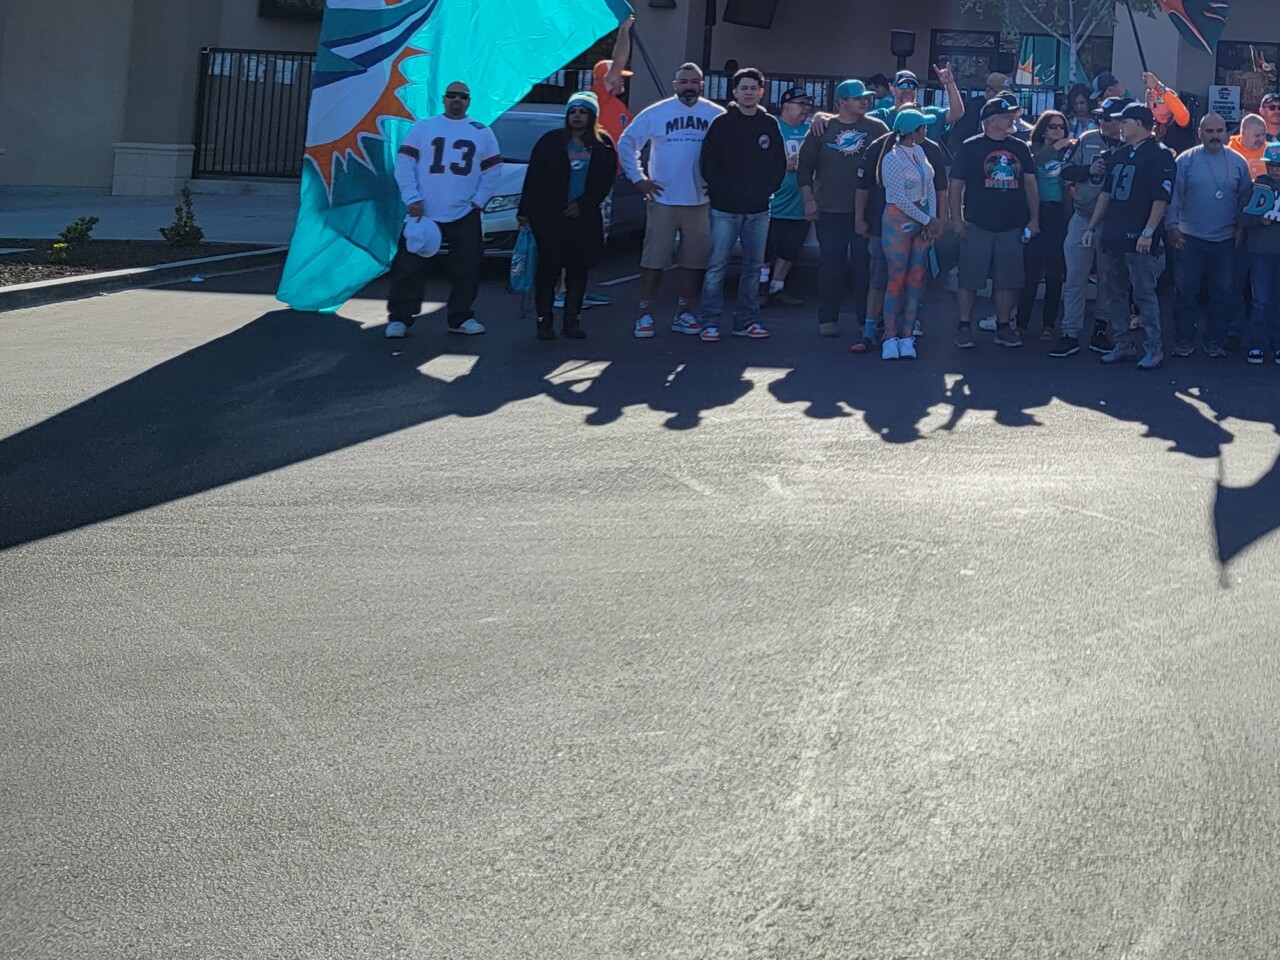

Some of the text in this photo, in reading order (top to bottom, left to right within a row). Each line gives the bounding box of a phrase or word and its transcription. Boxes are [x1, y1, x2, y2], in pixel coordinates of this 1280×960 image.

[666, 115, 709, 135] MIAM
[428, 135, 477, 178] 13
[1110, 163, 1137, 202] 13
